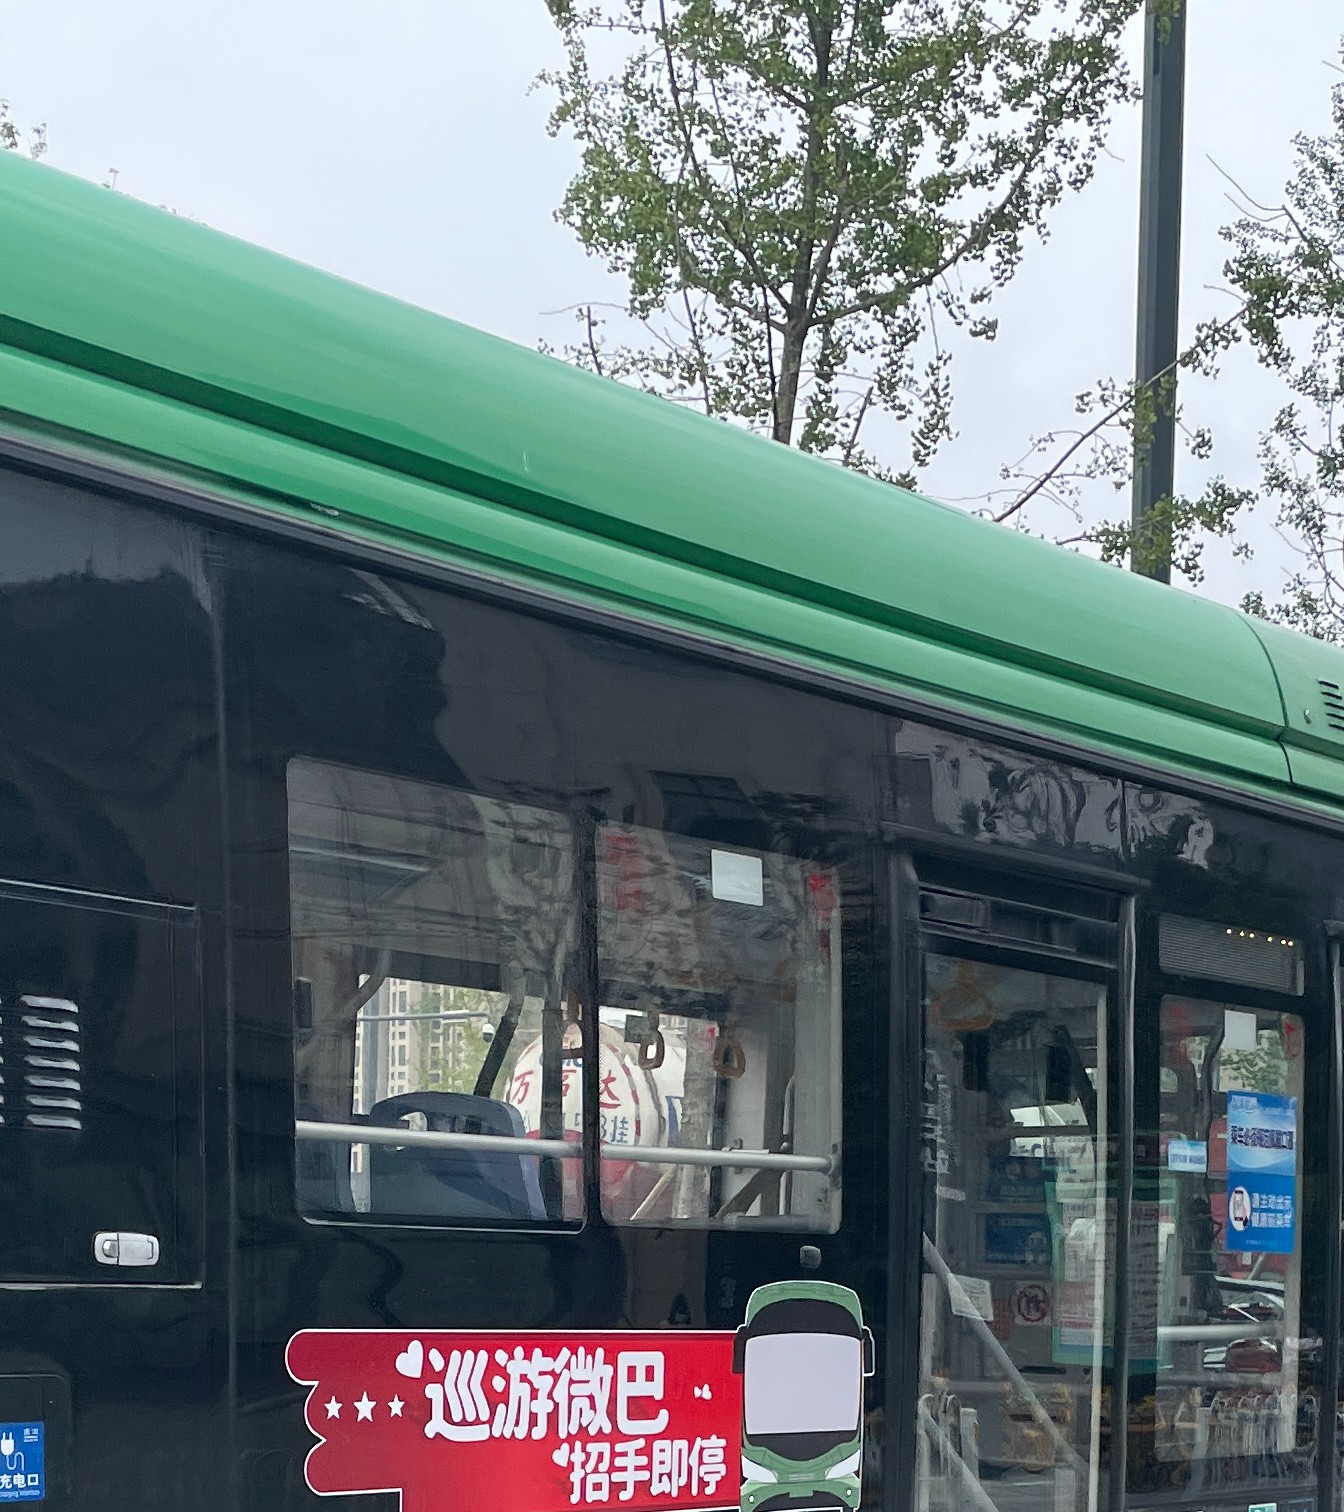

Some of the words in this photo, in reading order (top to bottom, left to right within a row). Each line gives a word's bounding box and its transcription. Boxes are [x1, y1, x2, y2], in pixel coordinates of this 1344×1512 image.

[424, 1346, 669, 1442] 巡游微巴
[0, 1473, 39, 1489] 充电口
[569, 1435, 727, 1505] 招手即停
